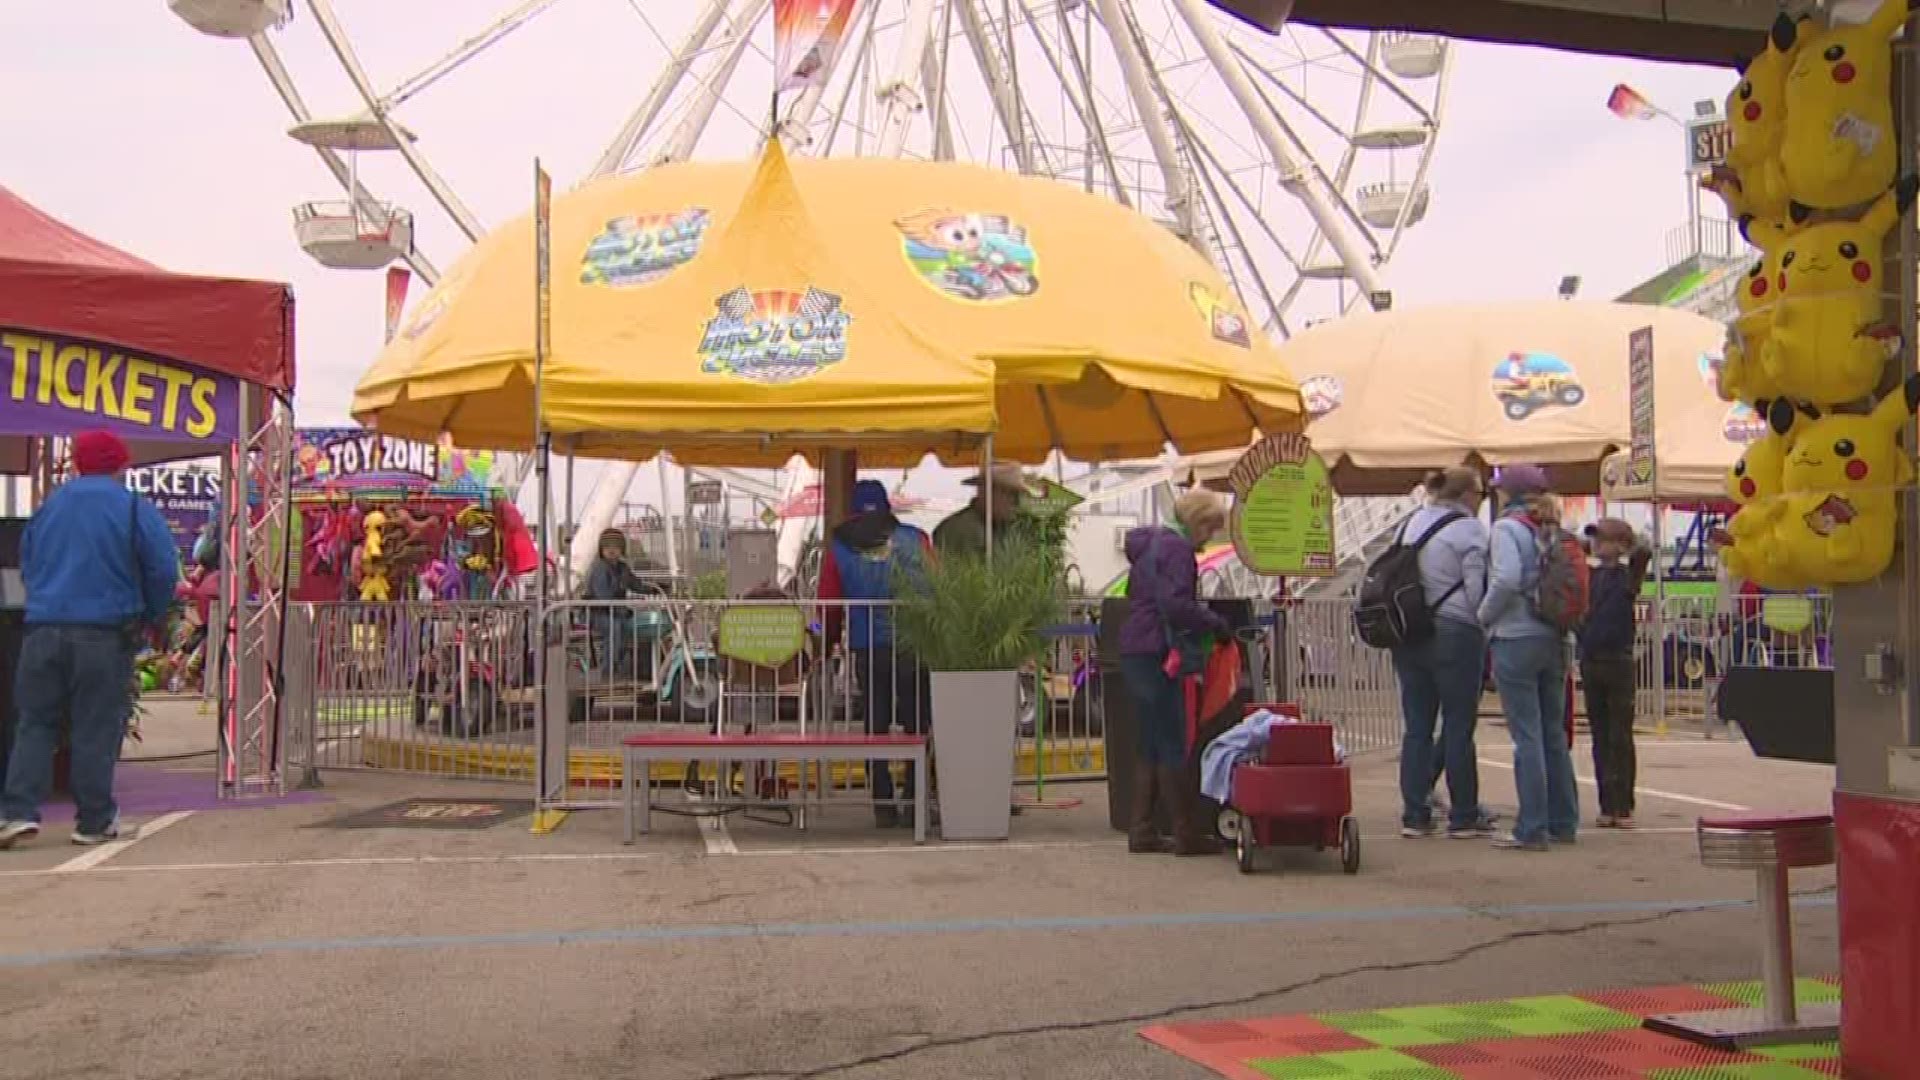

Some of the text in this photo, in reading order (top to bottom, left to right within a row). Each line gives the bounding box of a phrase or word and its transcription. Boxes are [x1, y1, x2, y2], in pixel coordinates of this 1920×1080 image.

[698, 313, 852, 354] MOTOR
[2, 334, 217, 438] TICKETS
[329, 435, 436, 479] TOY ZONE
[125, 467, 221, 495] ICKETS
[167, 499, 214, 511] GAMES
